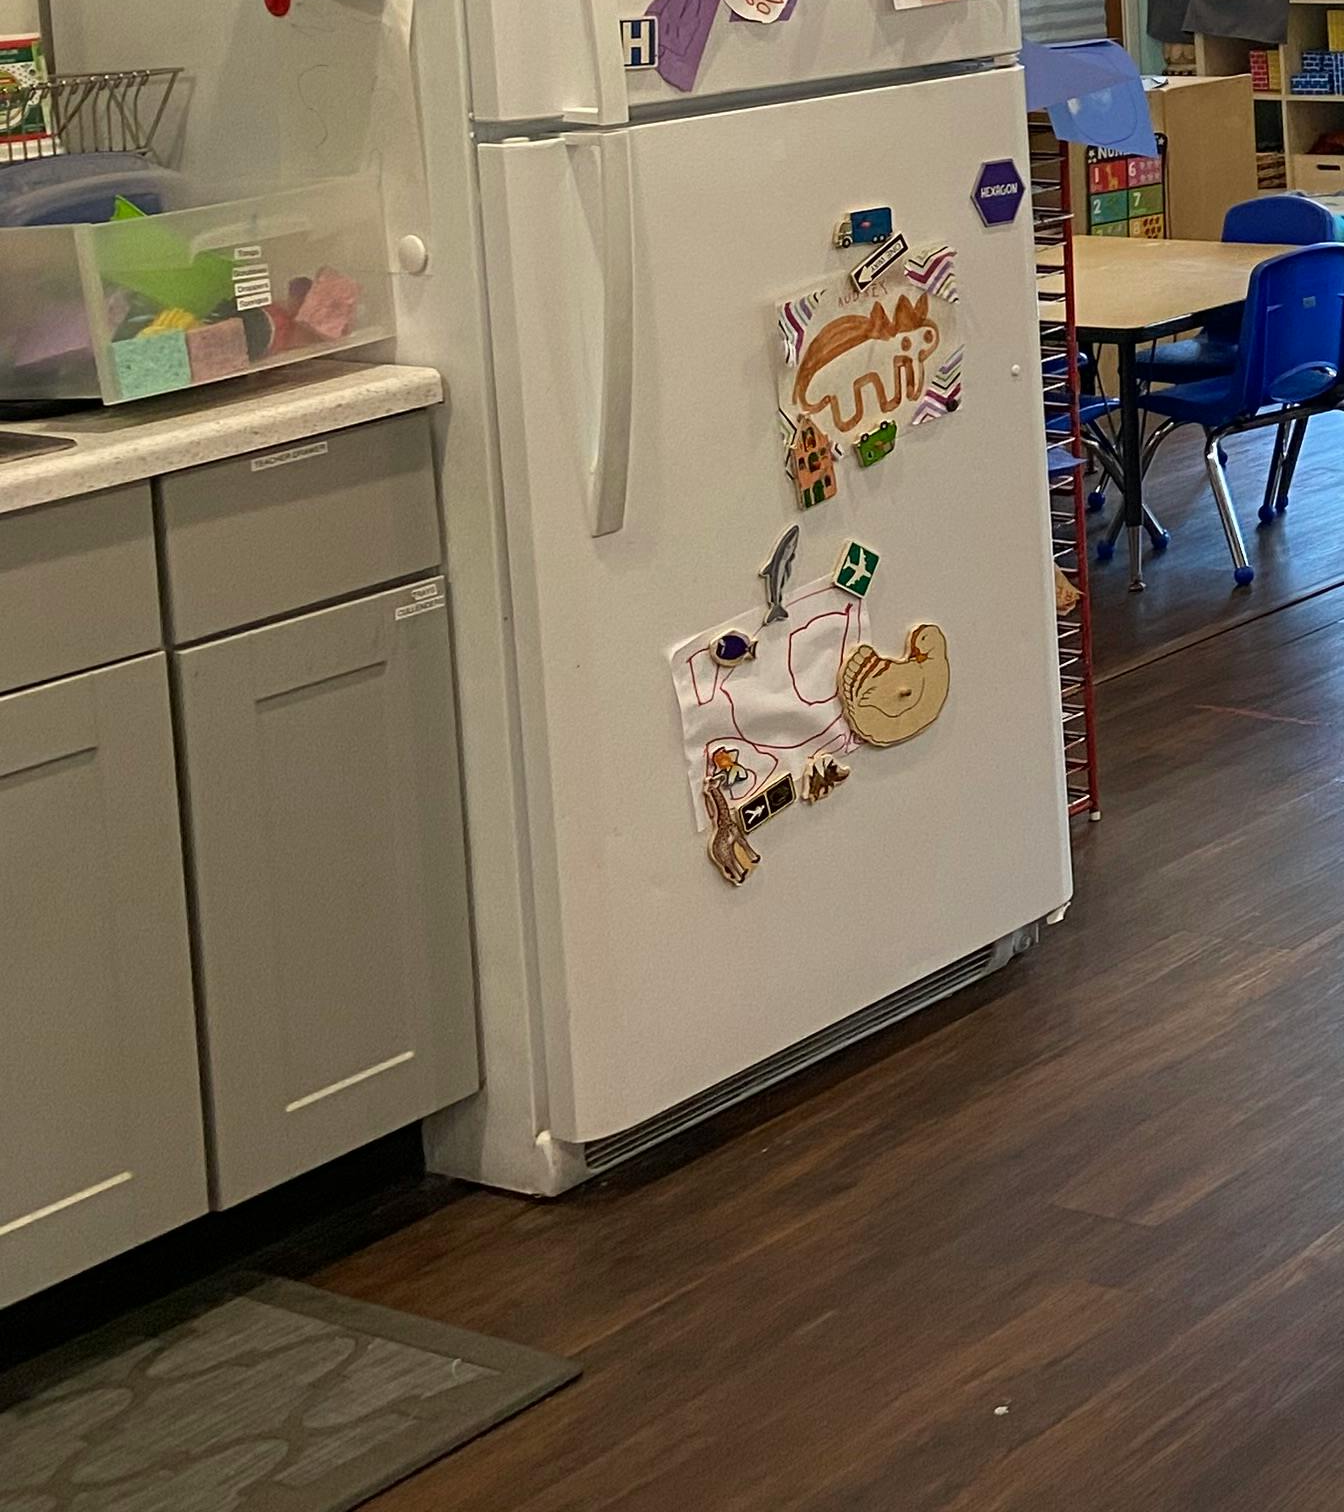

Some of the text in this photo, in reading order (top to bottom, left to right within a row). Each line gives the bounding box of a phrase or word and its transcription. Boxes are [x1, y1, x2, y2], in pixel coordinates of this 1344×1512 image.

[622, 20, 651, 66] H
[1094, 167, 1100, 183] 1
[1128, 162, 1137, 177] 6
[980, 182, 1018, 198] HEXAGON
[1093, 199, 1103, 215] 2
[1132, 192, 1141, 207] 7
[871, 242, 902, 272] ONE WAY
